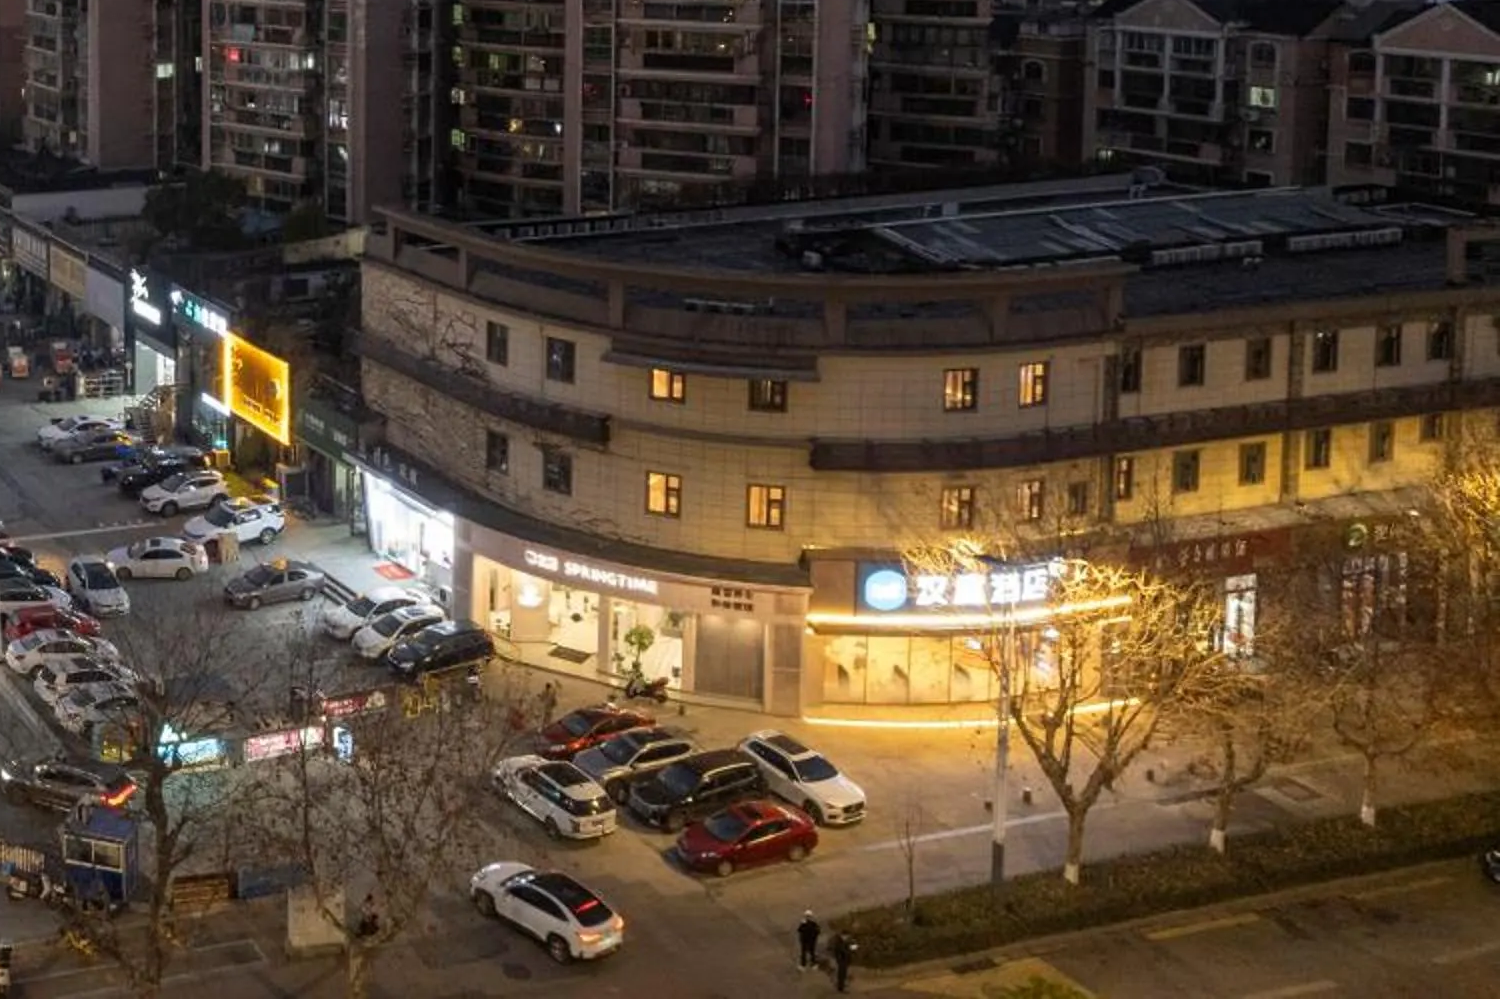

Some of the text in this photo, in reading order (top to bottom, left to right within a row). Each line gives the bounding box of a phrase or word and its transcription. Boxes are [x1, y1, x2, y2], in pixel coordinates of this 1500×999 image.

[563, 560, 658, 596] SPRINGTIME
[915, 568, 1049, 606] 汉酒店
